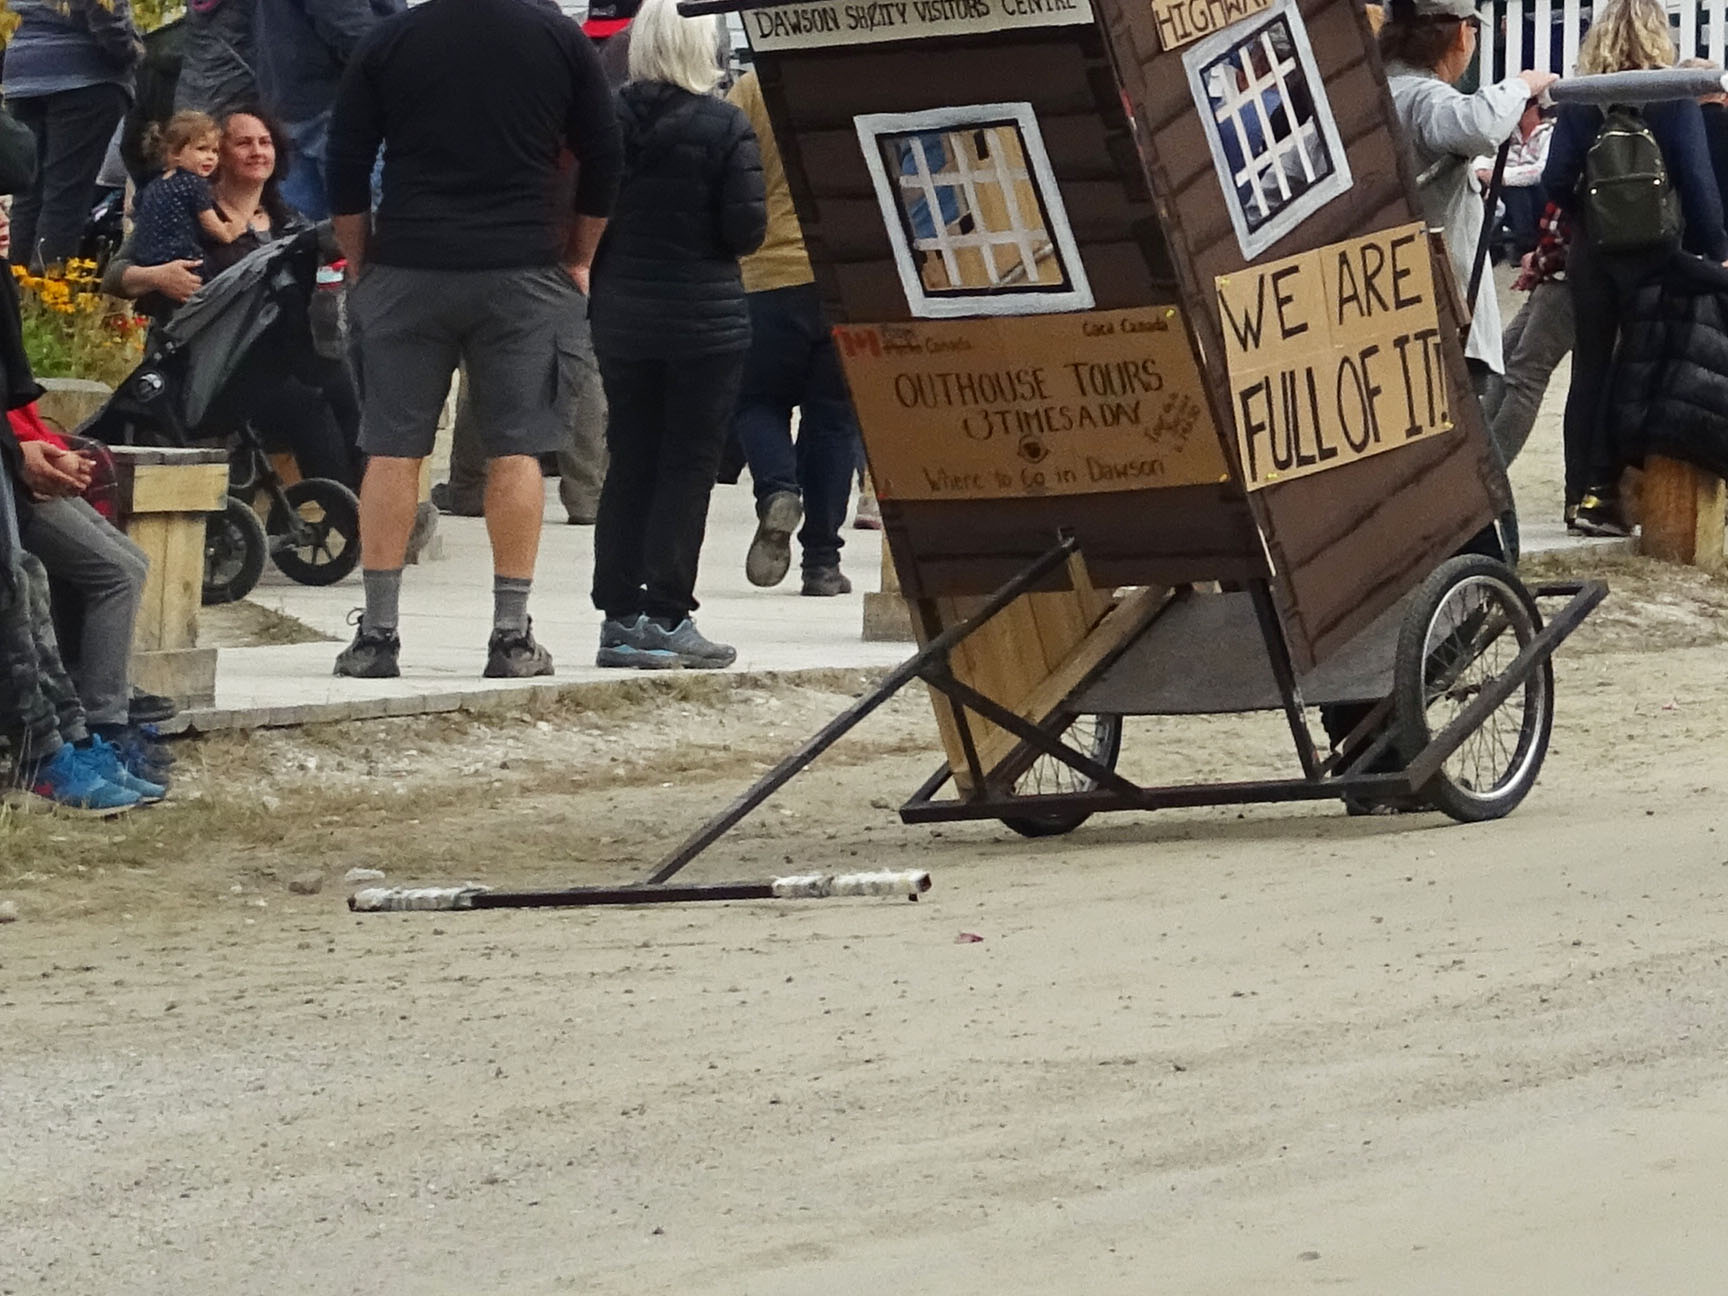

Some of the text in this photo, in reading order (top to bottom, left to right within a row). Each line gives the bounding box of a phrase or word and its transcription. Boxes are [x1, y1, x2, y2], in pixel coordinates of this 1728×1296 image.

[753, 9, 841, 39] DAWSON
[1219, 235, 1423, 352] WE ARE
[895, 359, 1164, 408] OUTHOUSE TOURS
[995, 405, 1074, 435] TIMES
[1101, 400, 1141, 428] DAY
[1239, 366, 1338, 482] FULL
[1336, 344, 1382, 454] OF
[1393, 328, 1448, 440] IT!
[922, 466, 983, 492] Where
[1057, 469, 1077, 484] in
[1086, 456, 1165, 483] Dawson
